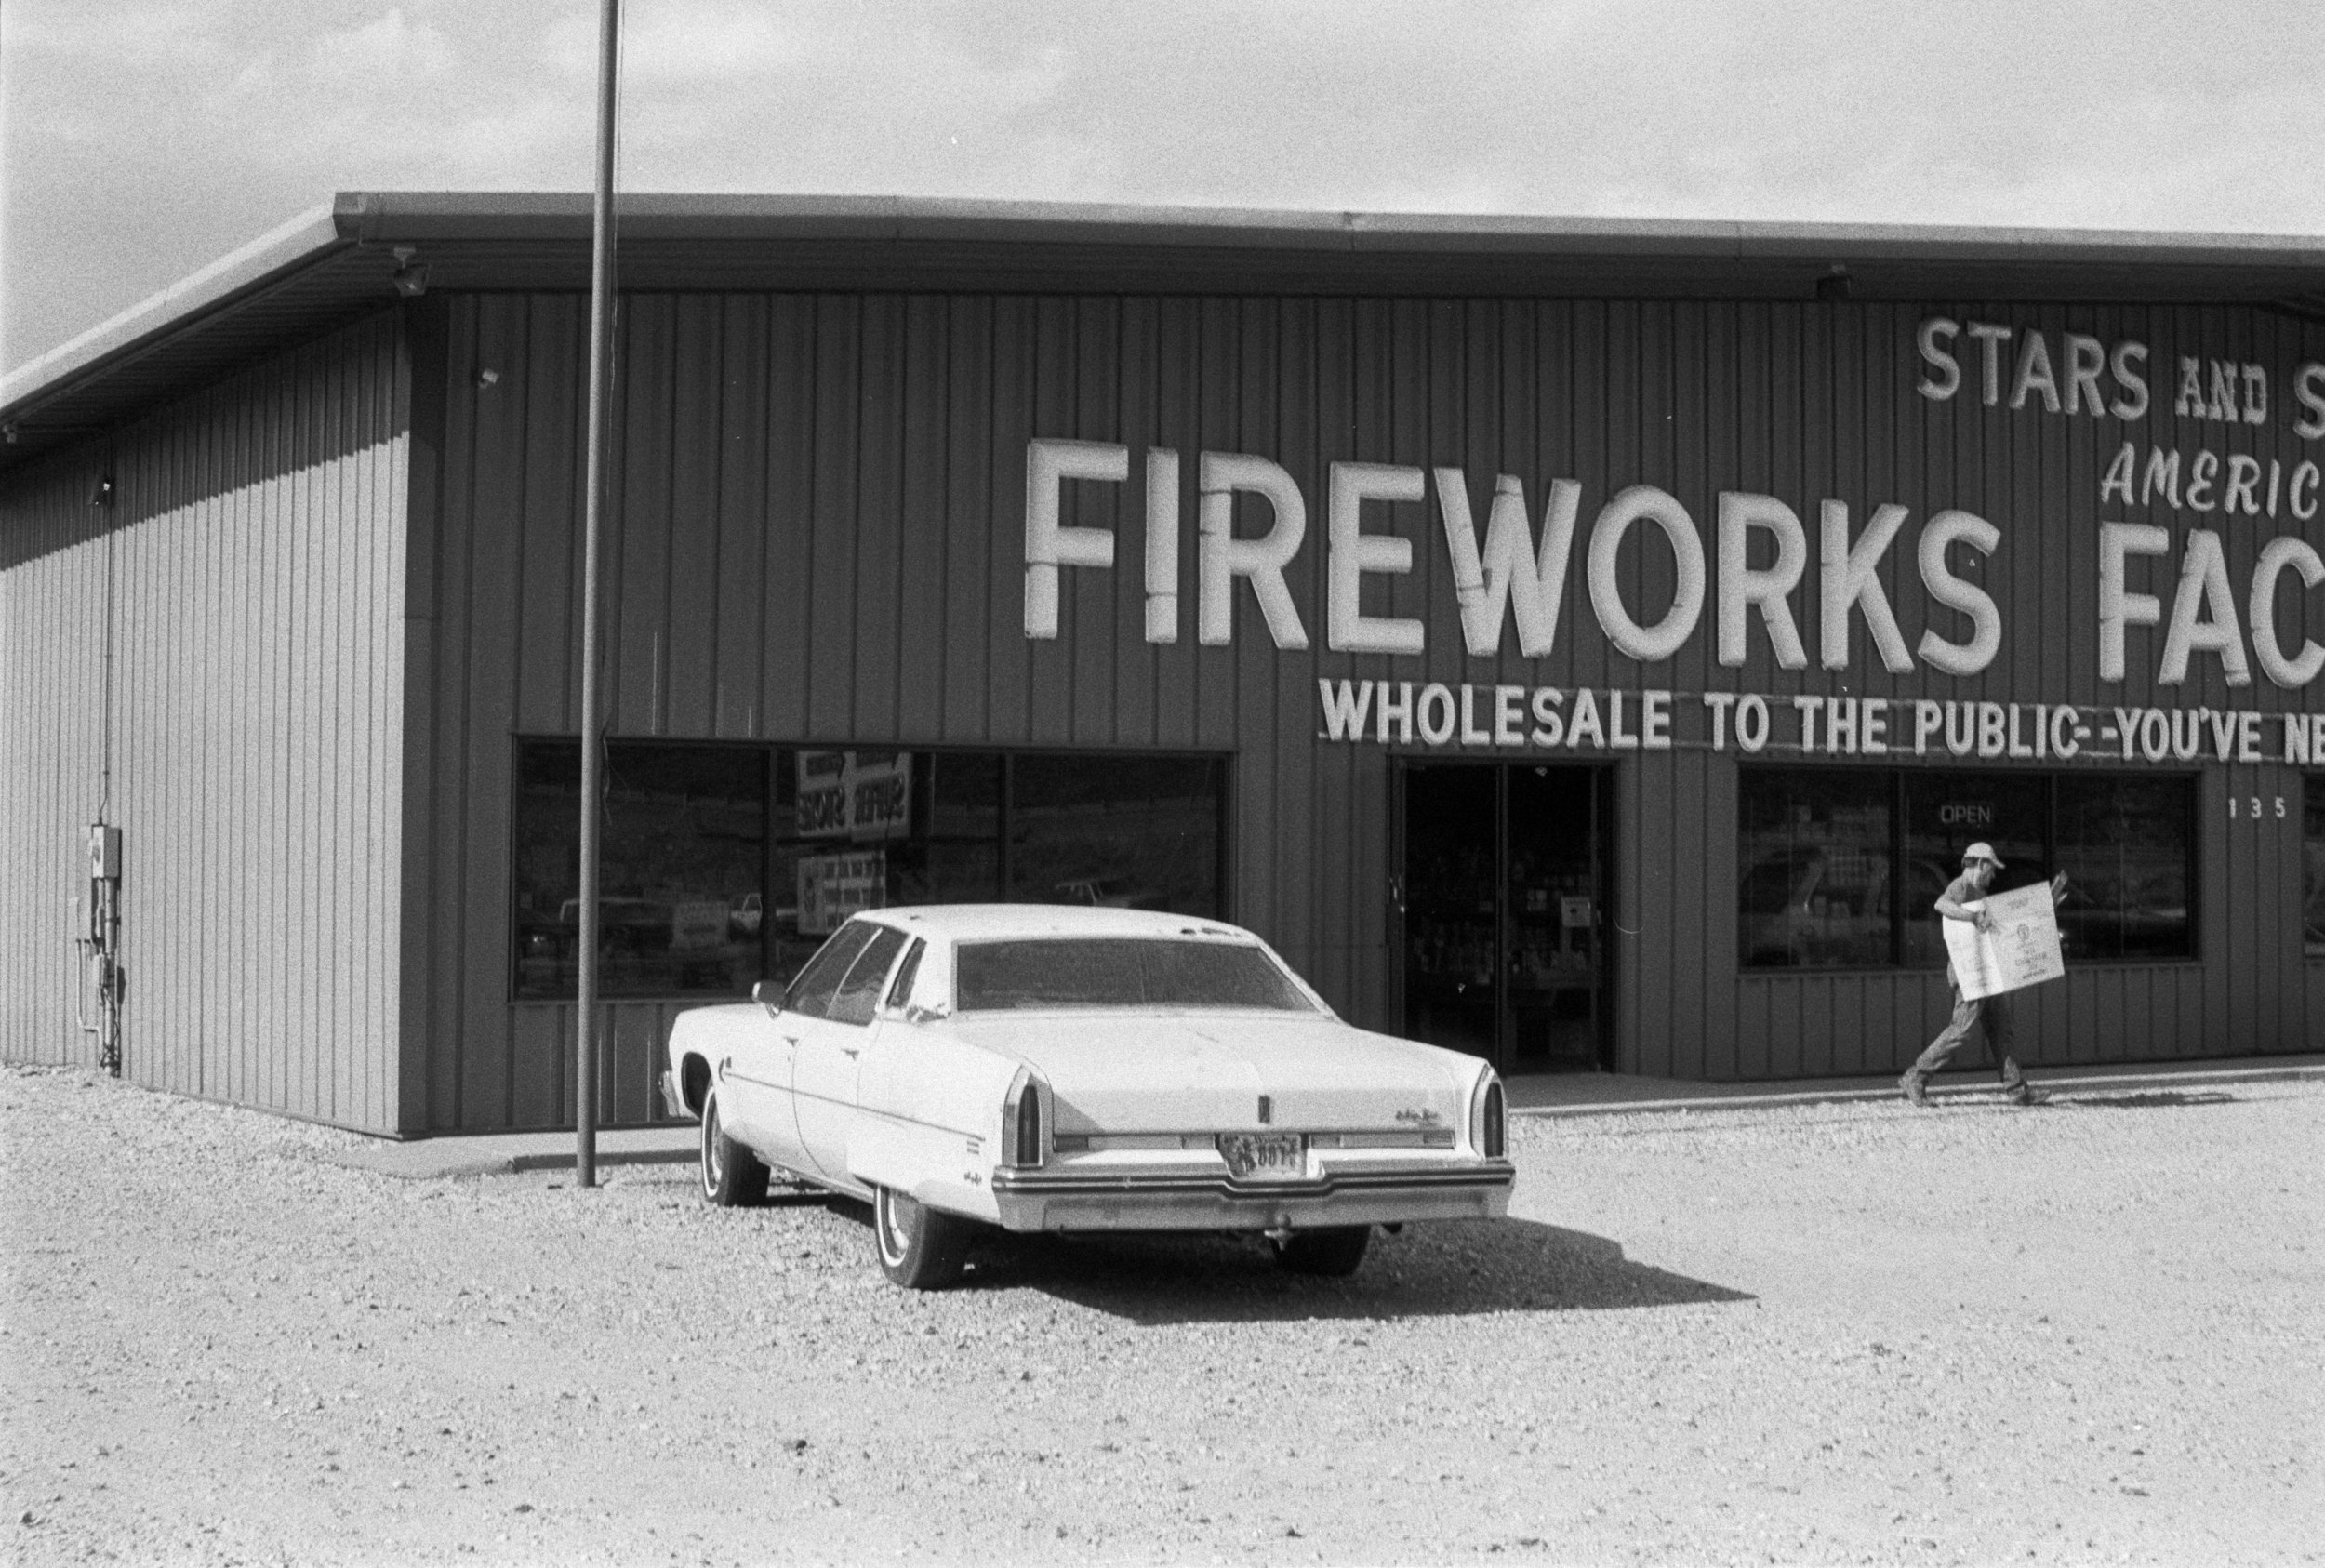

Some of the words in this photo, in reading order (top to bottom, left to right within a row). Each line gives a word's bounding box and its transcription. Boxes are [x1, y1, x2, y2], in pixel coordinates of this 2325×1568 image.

[1917, 317, 2149, 421] STARS
[2175, 356, 2267, 425] AND
[2101, 442, 2320, 520] AMERIC
[1024, 438, 2001, 676] FIREWORKS
[2099, 522, 2325, 689] FAC
[1319, 679, 1672, 747] WHOLESALE
[1704, 692, 1769, 751] TO
[1794, 696, 1888, 753] THE
[2285, 712, 2325, 764] NE
[1940, 804, 1992, 825] OPEN
